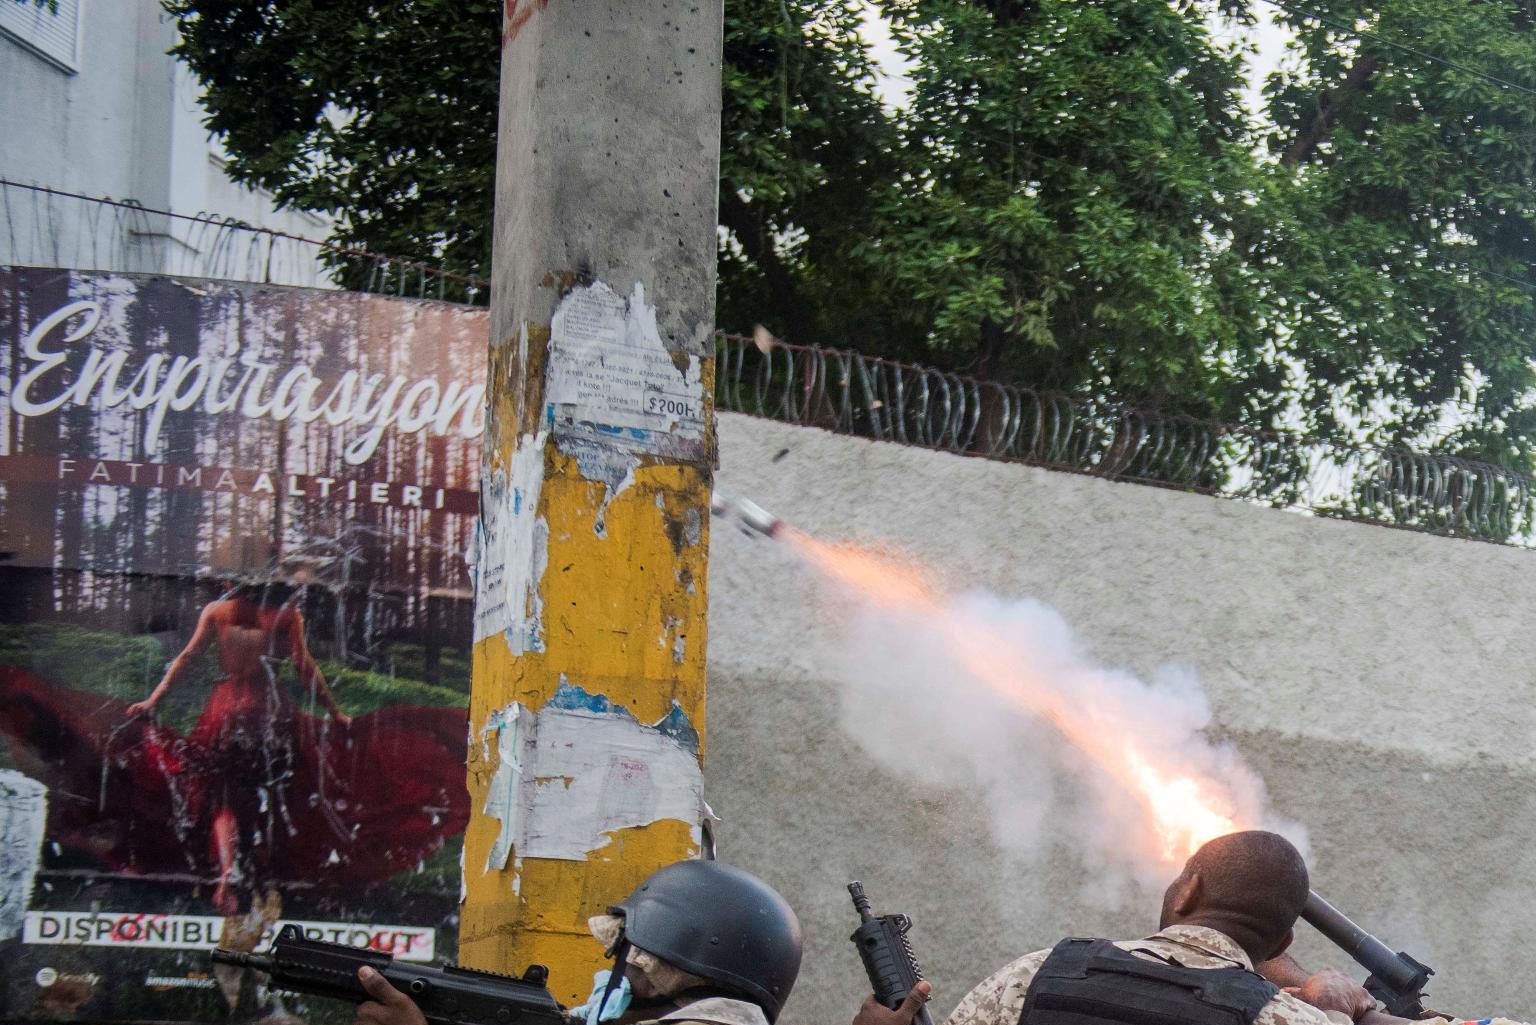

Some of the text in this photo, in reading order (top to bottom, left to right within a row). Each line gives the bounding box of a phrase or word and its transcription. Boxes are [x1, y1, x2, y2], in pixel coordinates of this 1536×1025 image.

[11, 300, 486, 465] Enspirasyon
[59, 460, 445, 509] FATIMA ALTIERI
[39, 916, 221, 945] DISPONIBL
